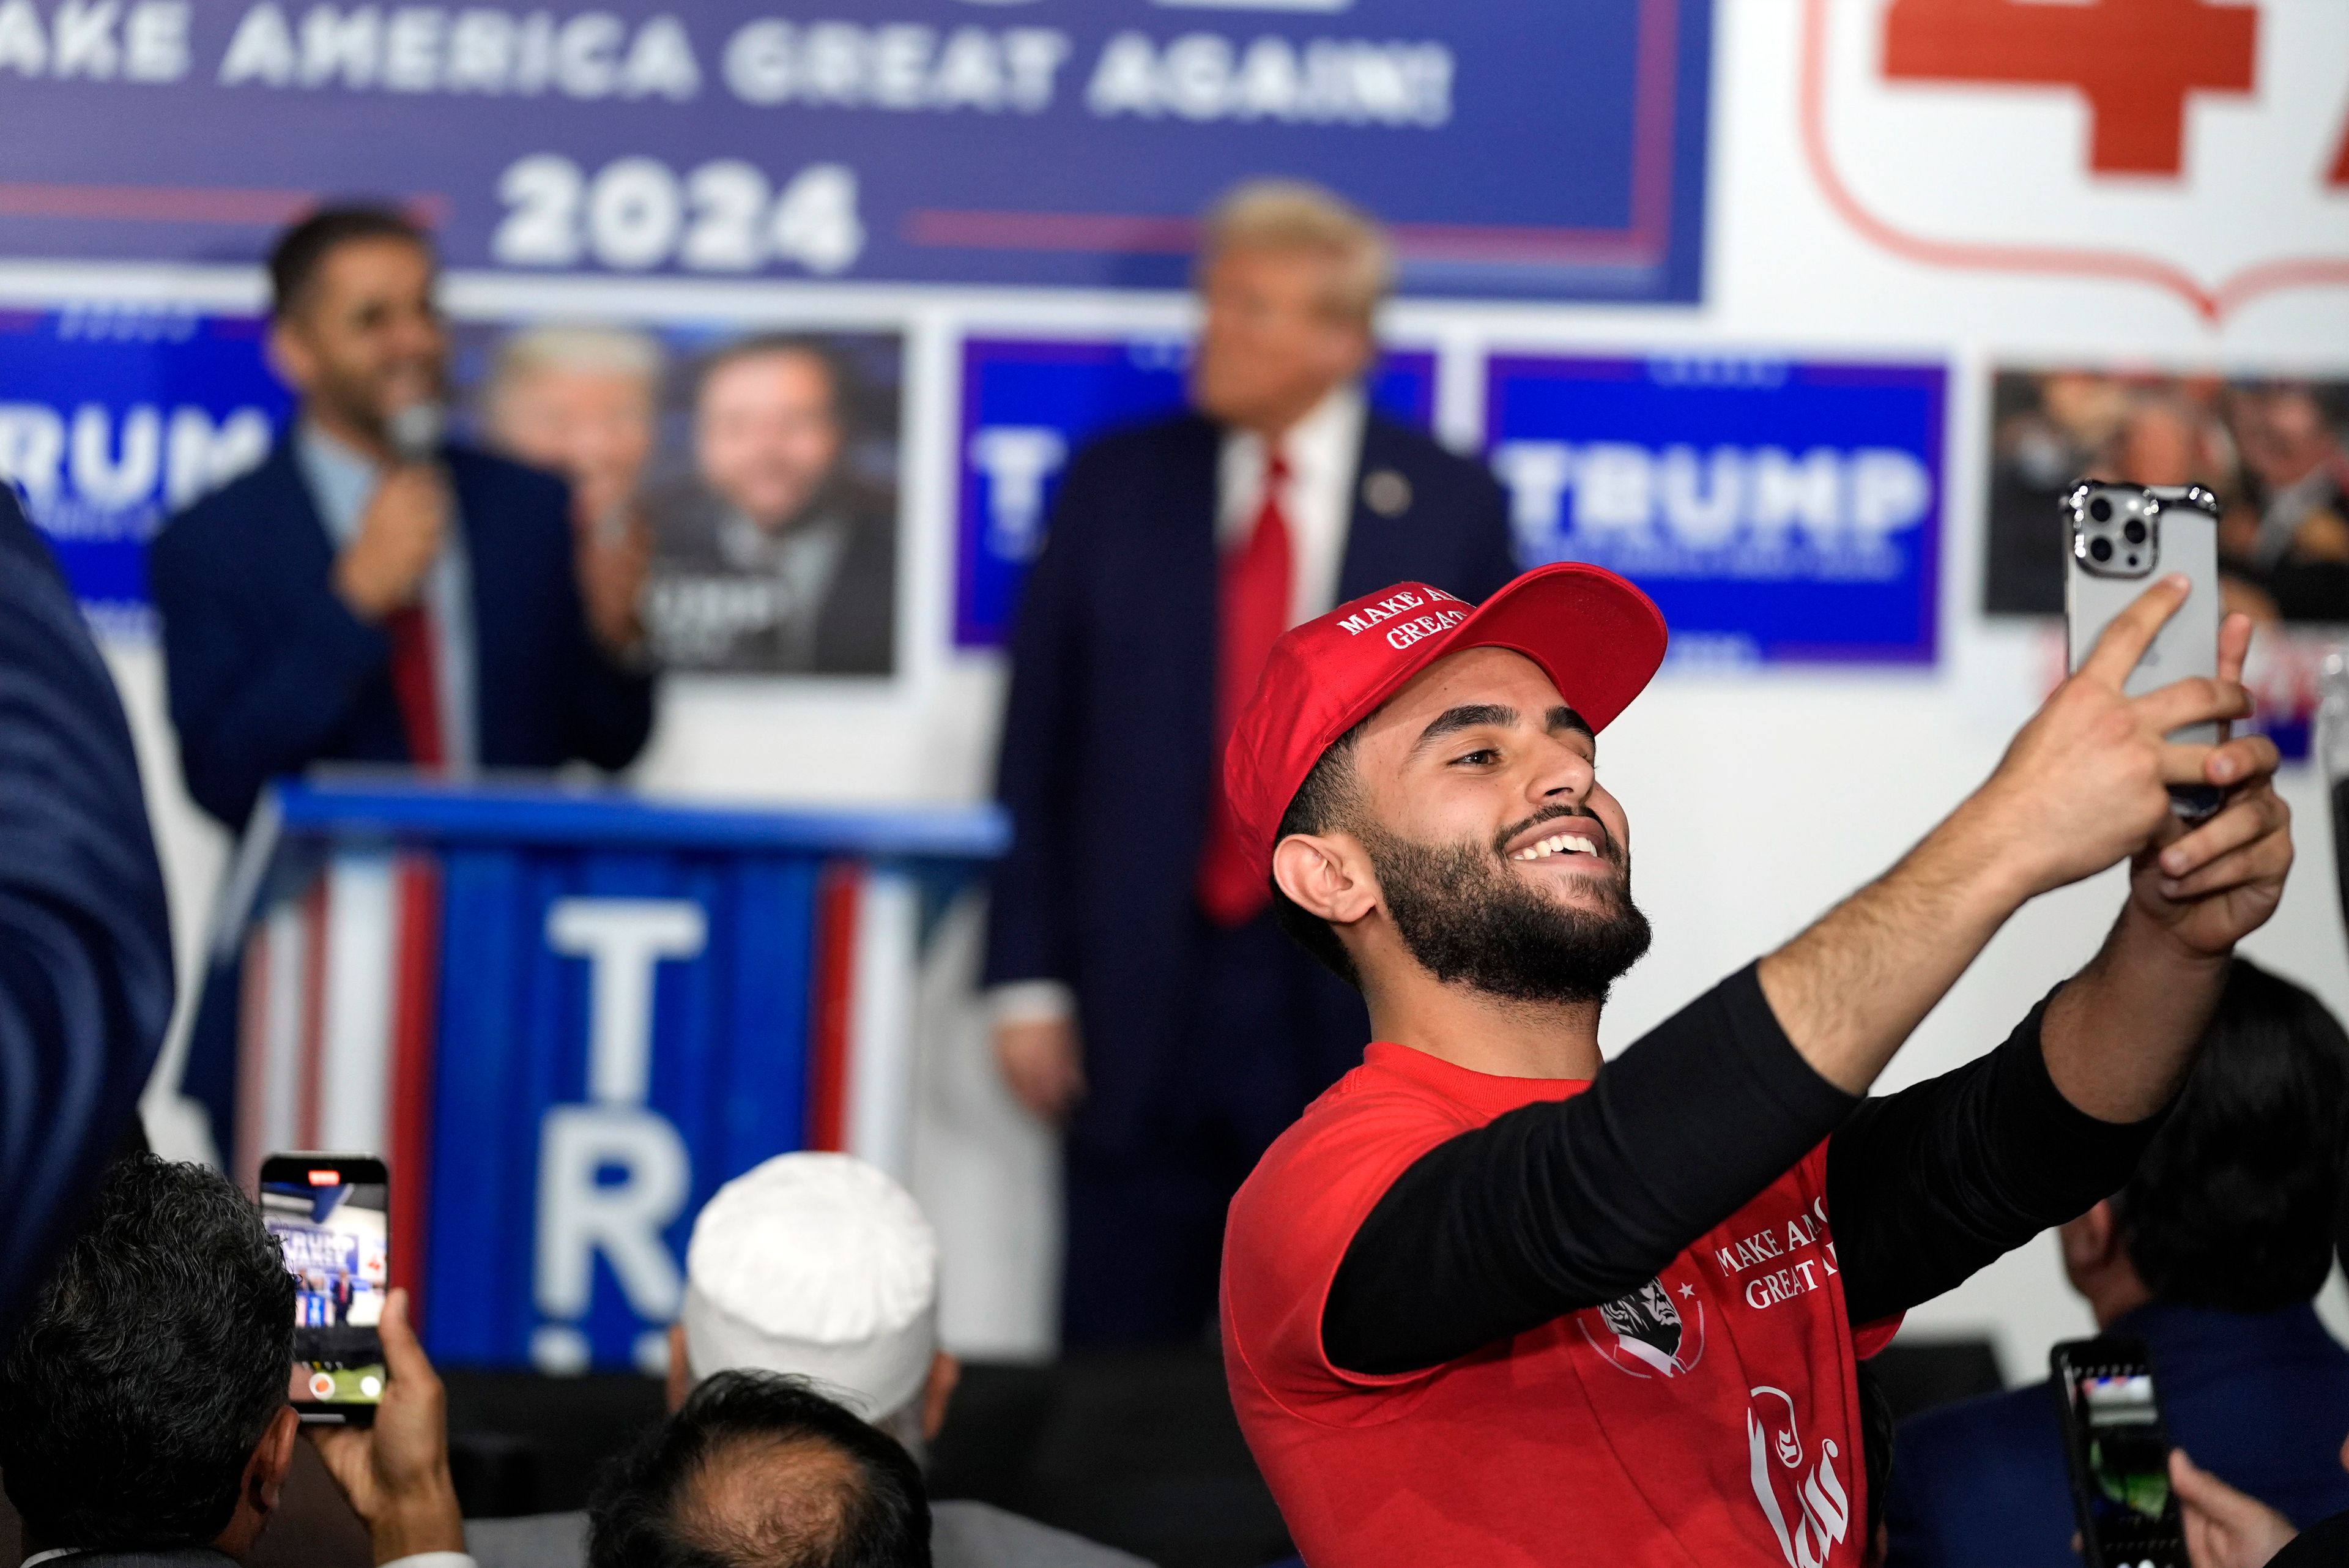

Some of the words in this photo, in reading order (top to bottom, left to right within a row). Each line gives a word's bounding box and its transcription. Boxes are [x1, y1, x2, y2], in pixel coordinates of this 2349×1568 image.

[219, 7, 700, 101] AMERICA
[723, 17, 1071, 114] GREAT
[1086, 32, 1454, 128] AGAIN!
[497, 154, 864, 273] 2024
[1494, 440, 1929, 548] TRUMP
[1337, 591, 1424, 636] MAKE
[1715, 1229, 1784, 1277] MAKE
[1746, 1259, 1819, 1309] GREAT
